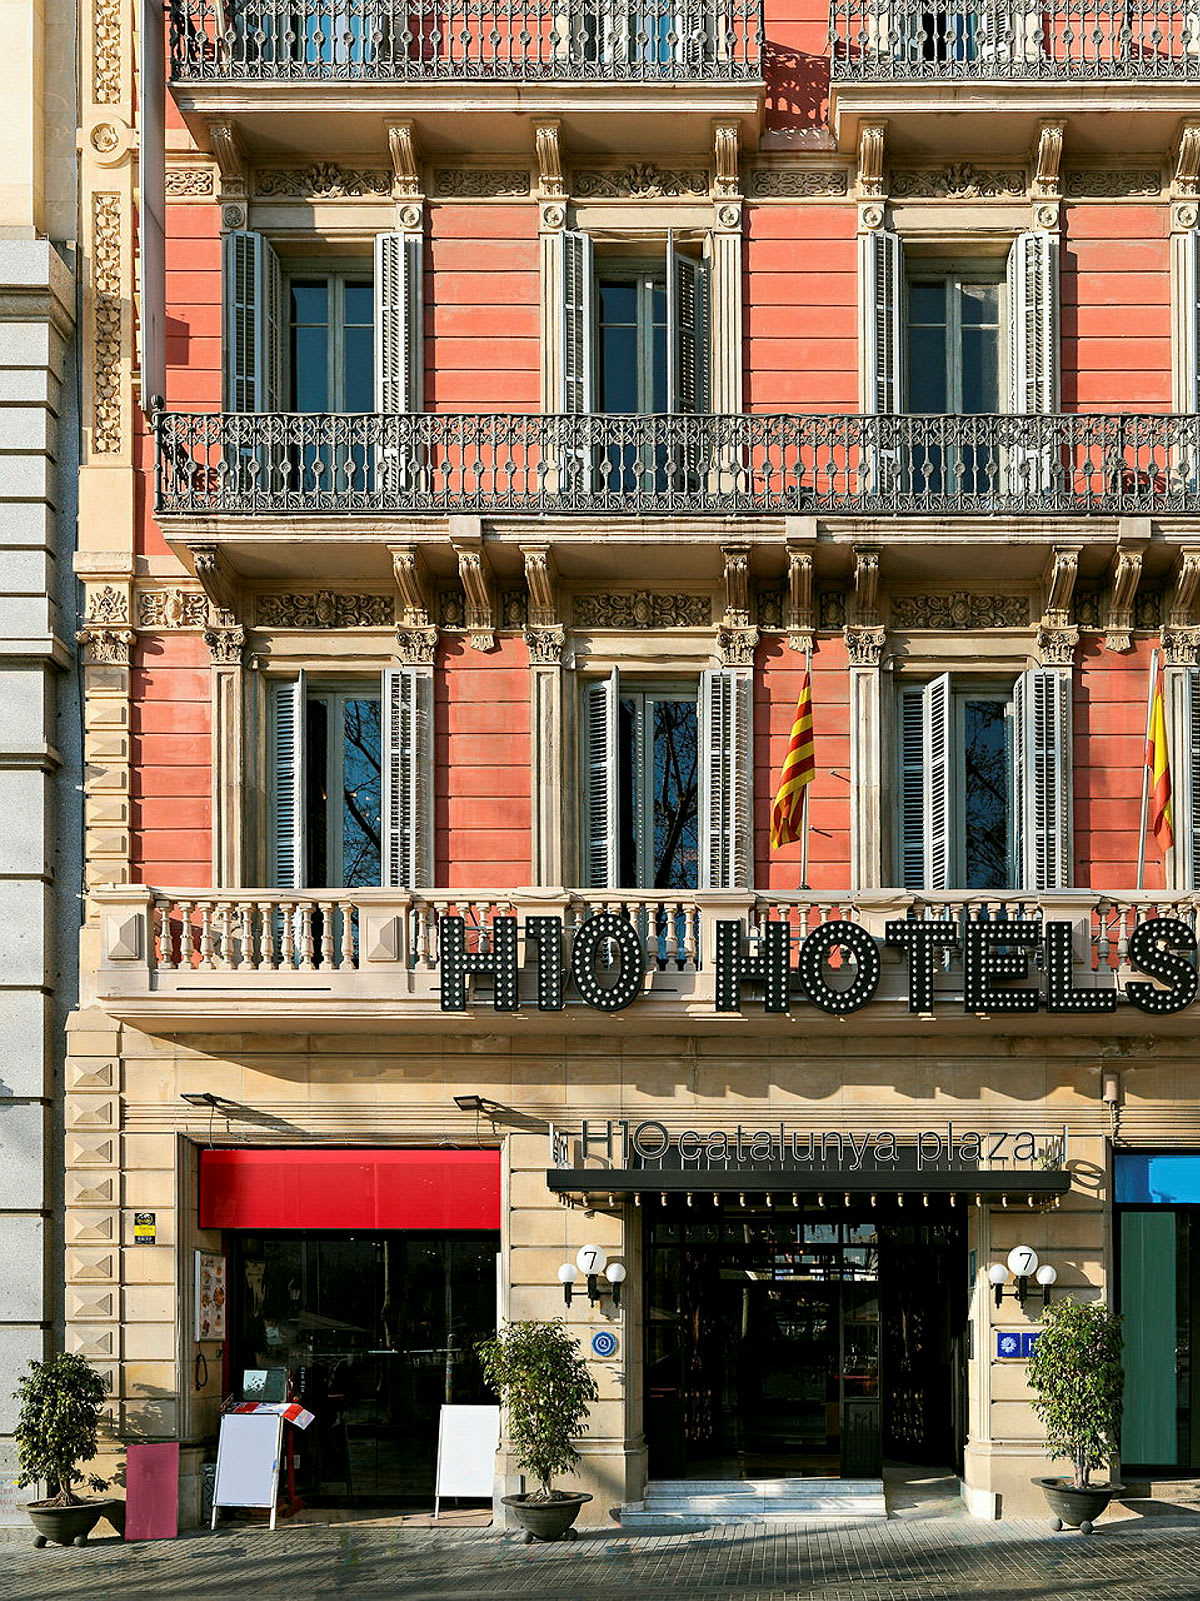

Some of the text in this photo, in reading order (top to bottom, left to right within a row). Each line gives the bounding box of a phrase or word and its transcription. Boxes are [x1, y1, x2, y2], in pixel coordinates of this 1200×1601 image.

[440, 913, 1199, 1015] H10 HOTELS
[581, 1120, 670, 1160] H10
[678, 1122, 899, 1171] catalunya
[917, 1120, 1038, 1171] plaza
[583, 1251, 598, 1270] 7
[1019, 1252, 1032, 1271] 7
